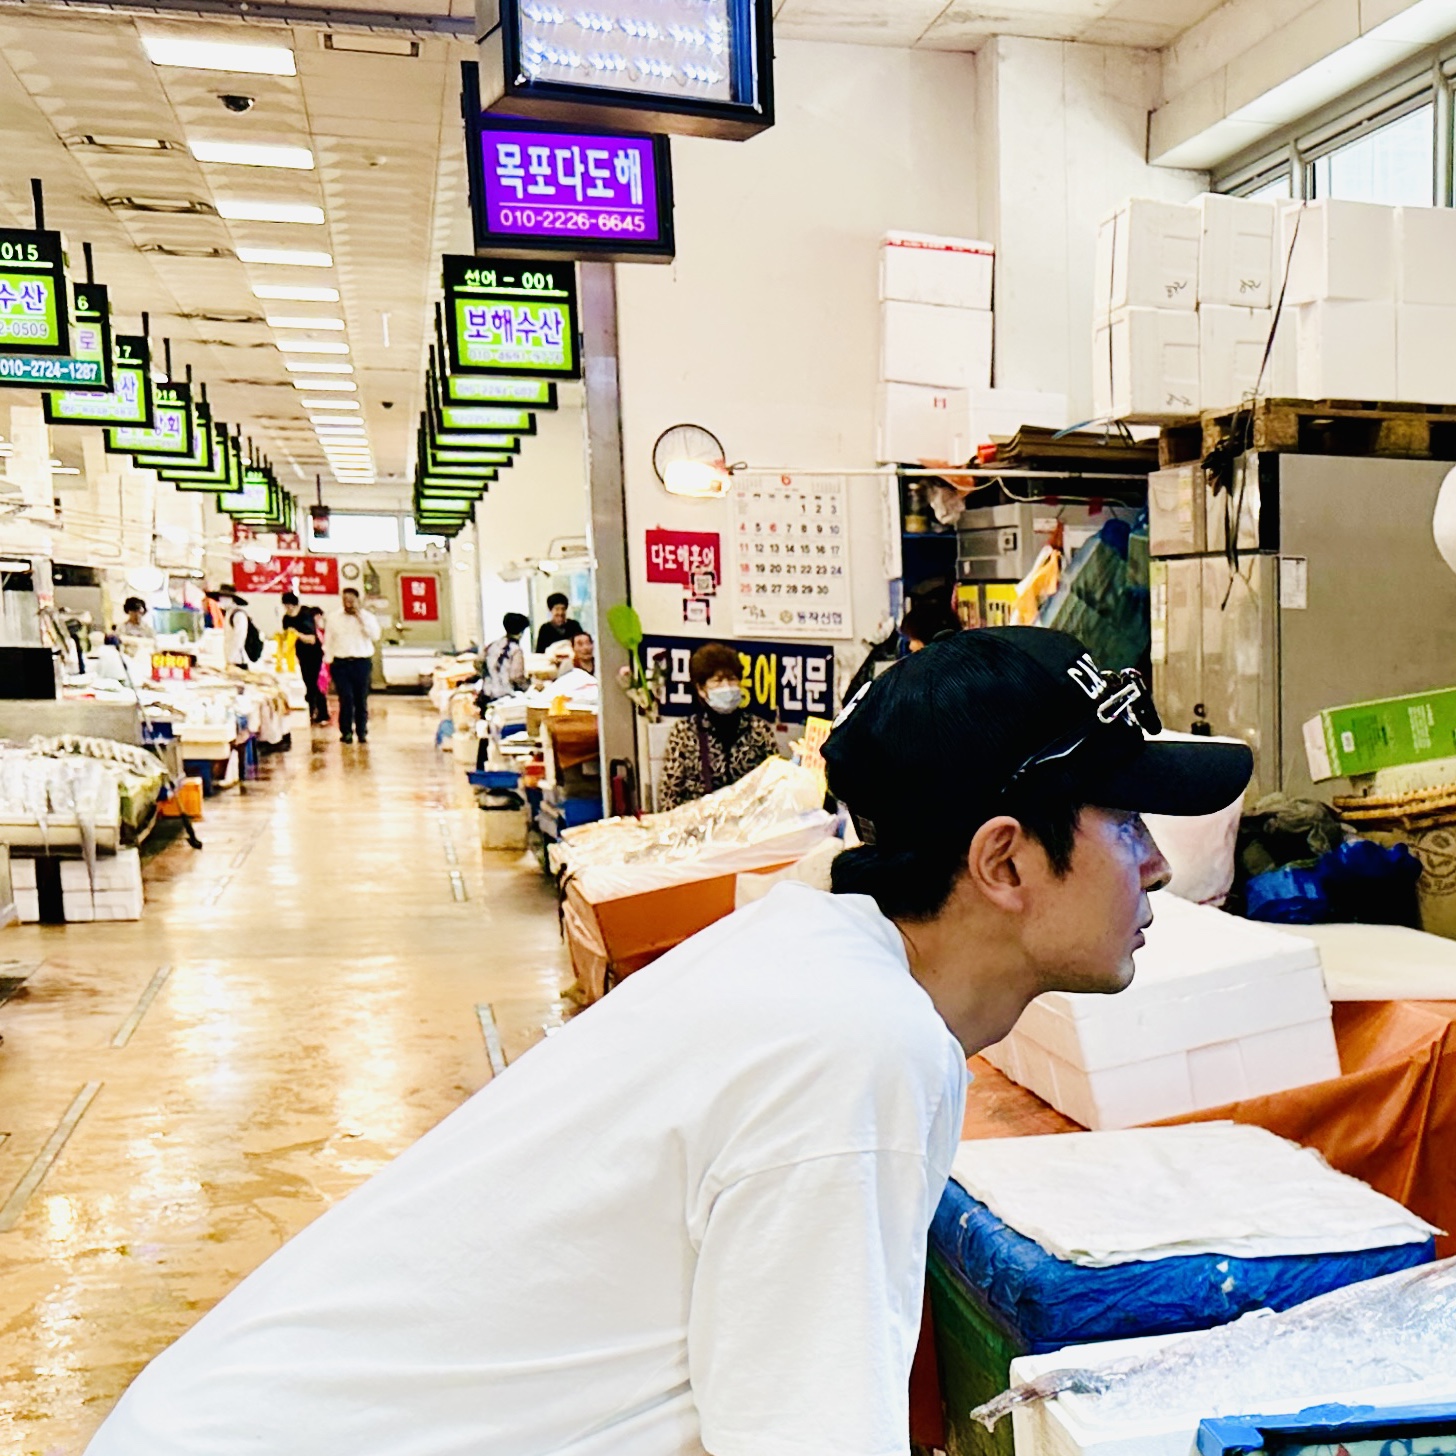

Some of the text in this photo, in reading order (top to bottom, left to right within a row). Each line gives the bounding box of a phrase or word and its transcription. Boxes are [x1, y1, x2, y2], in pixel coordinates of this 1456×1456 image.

[495, 143, 643, 205] 목포다도해
[500, 210, 646, 232] 010-2226-6645
[521, 272, 554, 289] 001
[467, 309, 562, 346] 보해수산
